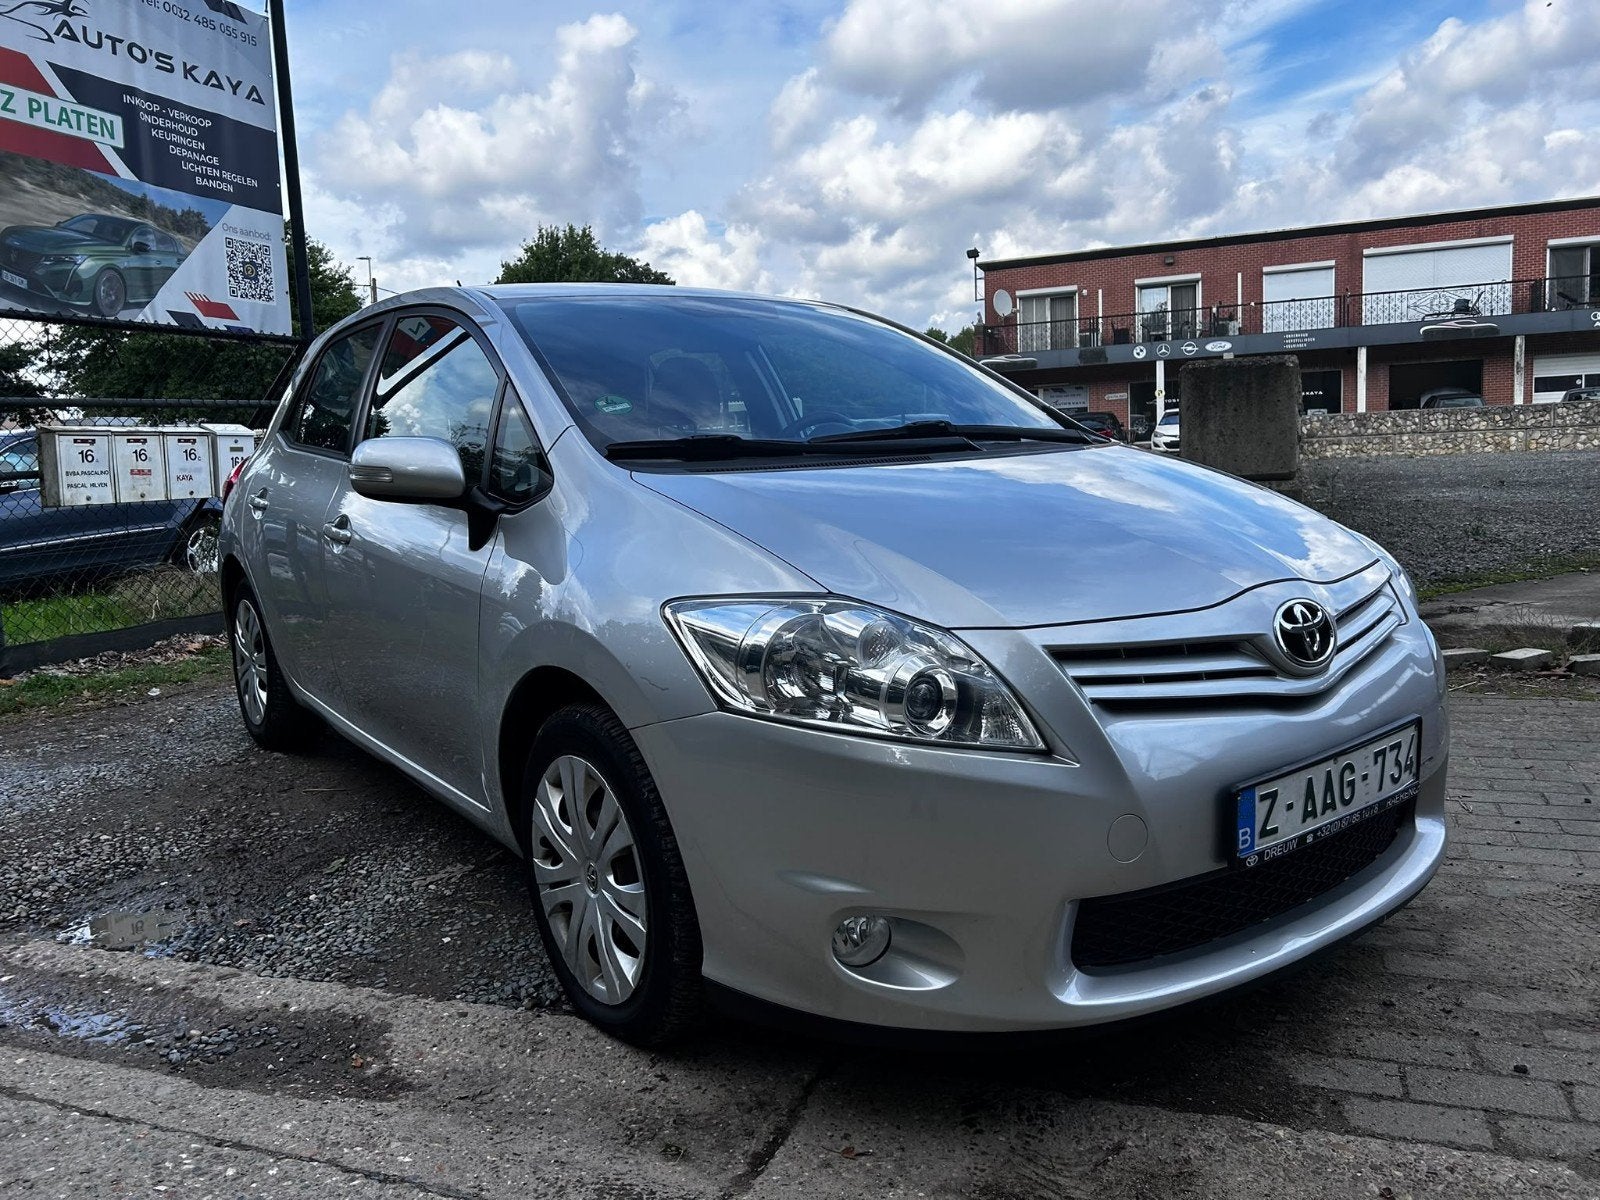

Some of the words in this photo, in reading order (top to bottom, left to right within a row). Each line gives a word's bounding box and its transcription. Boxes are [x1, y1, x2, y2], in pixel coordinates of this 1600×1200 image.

[141, 0, 160, 9] el:
[163, 1, 191, 22] 0032
[194, 15, 216, 31] 485
[220, 23, 238, 39] 055
[240, 32, 257, 47] 915
[53, 19, 175, 74] AUTO'S
[182, 61, 266, 106] KAYA
[0, 88, 16, 114] Z
[28, 97, 116, 140] PLATEN
[122, 94, 160, 113] INKOOP
[167, 107, 212, 128] VERKOOP
[139, 111, 198, 137] ONDERHOUD
[151, 128, 205, 151] KEURINGEN
[169, 145, 220, 166] DEPANAGE
[181, 160, 220, 178] LICHTEN
[221, 170, 258, 188] REGELEN
[195, 176, 234, 193] BANDEN
[222, 222, 238, 234] Ons
[1238, 827, 1251, 850] B
[1263, 838, 1299, 861] DREUW
